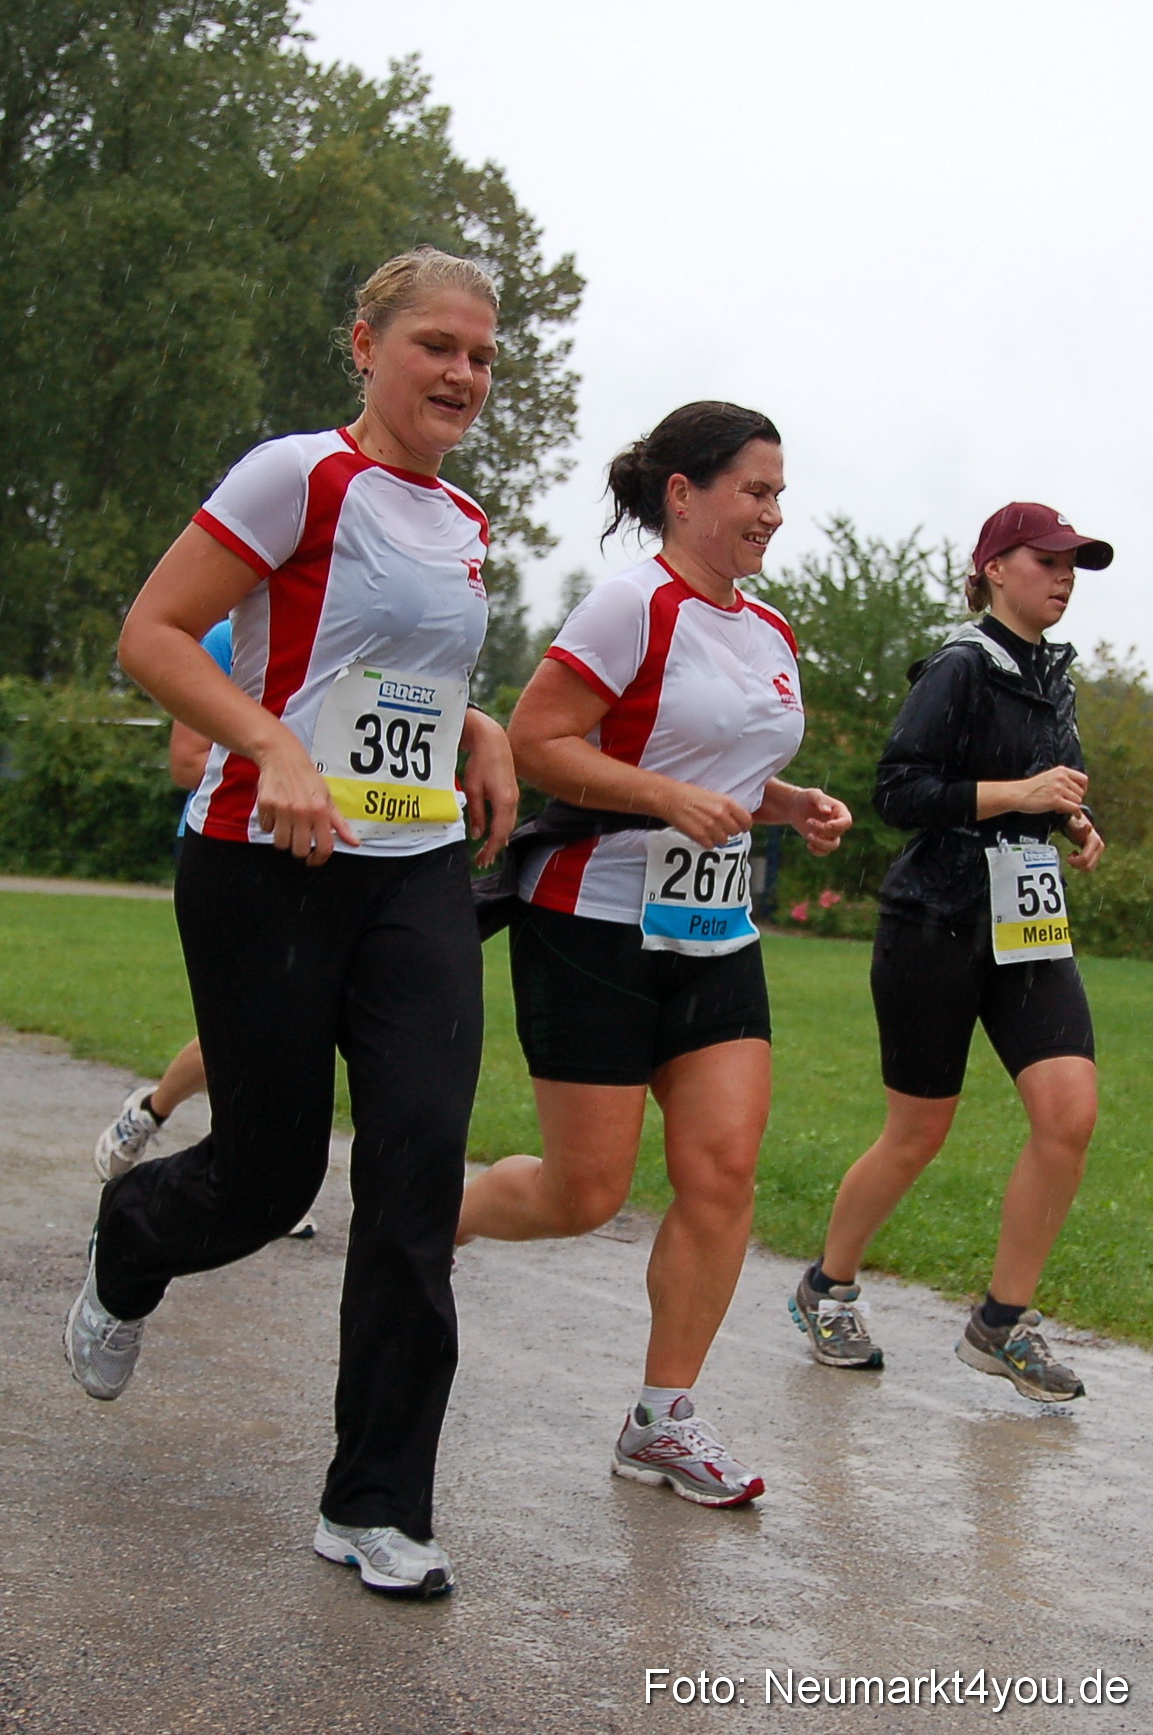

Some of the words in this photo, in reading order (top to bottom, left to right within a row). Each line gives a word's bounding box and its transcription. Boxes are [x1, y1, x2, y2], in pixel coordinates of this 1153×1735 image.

[379, 681, 436, 704] BOCK
[350, 713, 436, 781] 395
[364, 790, 420, 821] Sigrid
[660, 847, 747, 903] 2678
[649, 892, 656, 901] D
[1017, 872, 1062, 917] 53
[689, 915, 727, 936] Petra
